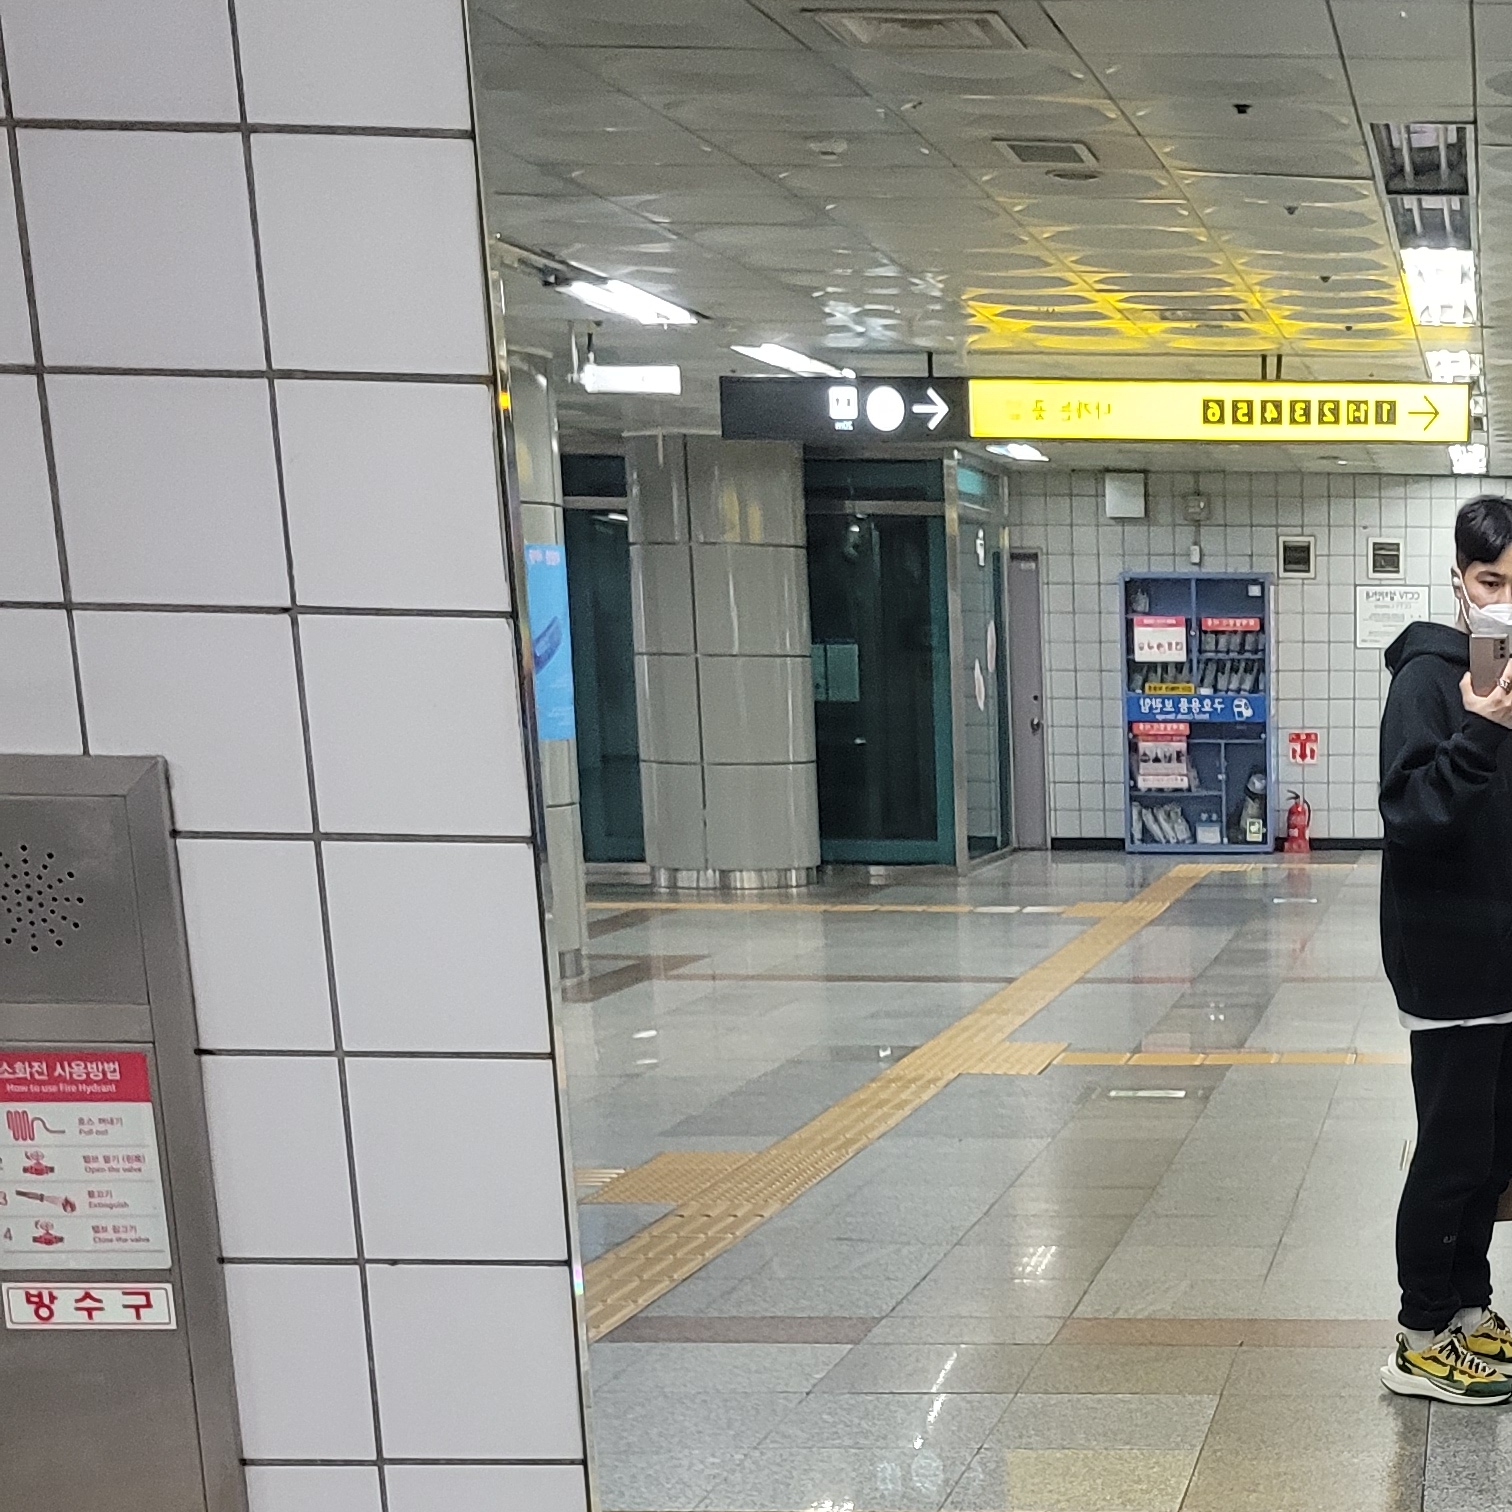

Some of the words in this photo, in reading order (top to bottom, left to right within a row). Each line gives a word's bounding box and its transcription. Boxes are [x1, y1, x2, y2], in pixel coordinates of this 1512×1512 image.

[0, 1060, 48, 1080] 소화전
[53, 1060, 121, 1080] 사용방법
[6, 1083, 28, 1093] How
[30, 1084, 40, 1093] to
[41, 1085, 57, 1093] use
[60, 1083, 77, 1093] Fire
[79, 1083, 117, 1094] Hydrant
[3, 1227, 13, 1242] 4
